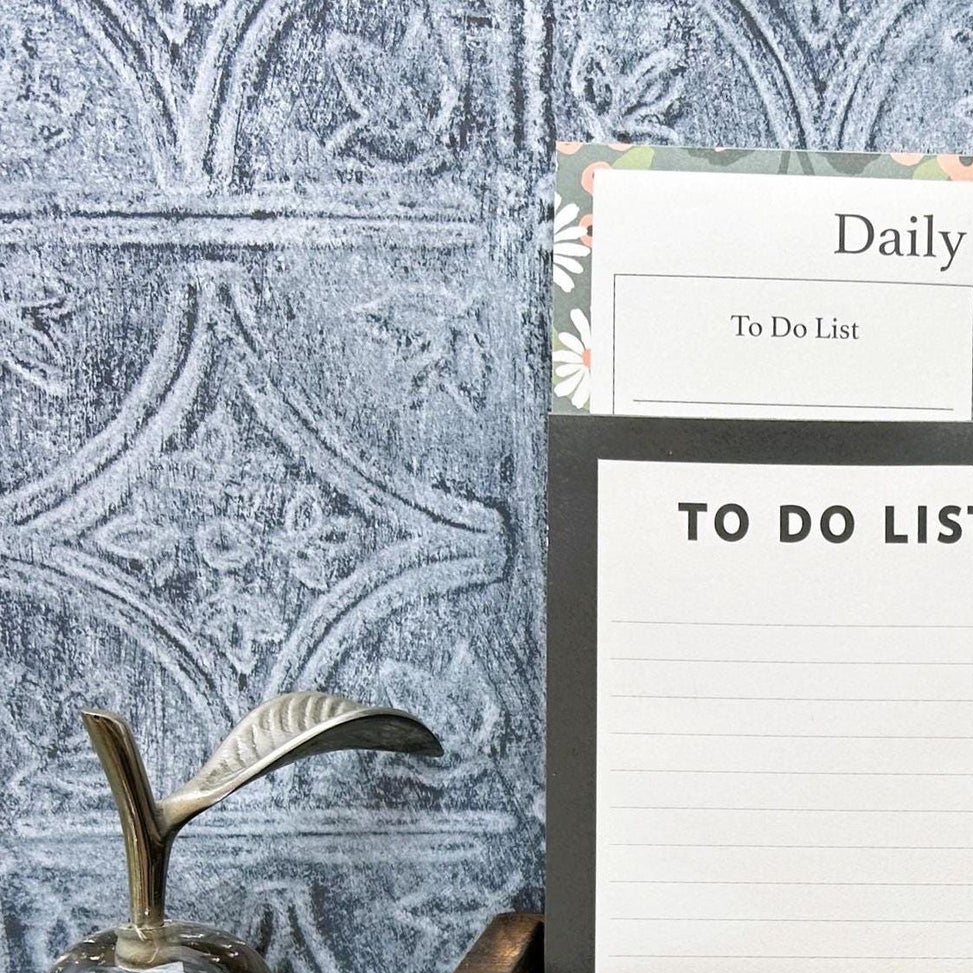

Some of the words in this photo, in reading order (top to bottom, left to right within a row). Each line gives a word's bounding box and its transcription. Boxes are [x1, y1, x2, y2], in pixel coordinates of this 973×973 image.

[834, 212, 966, 271] Daily
[731, 314, 763, 340] To
[771, 316, 808, 340] Do
[816, 316, 860, 342] List
[678, 501, 750, 544] TO
[778, 504, 857, 544] DO
